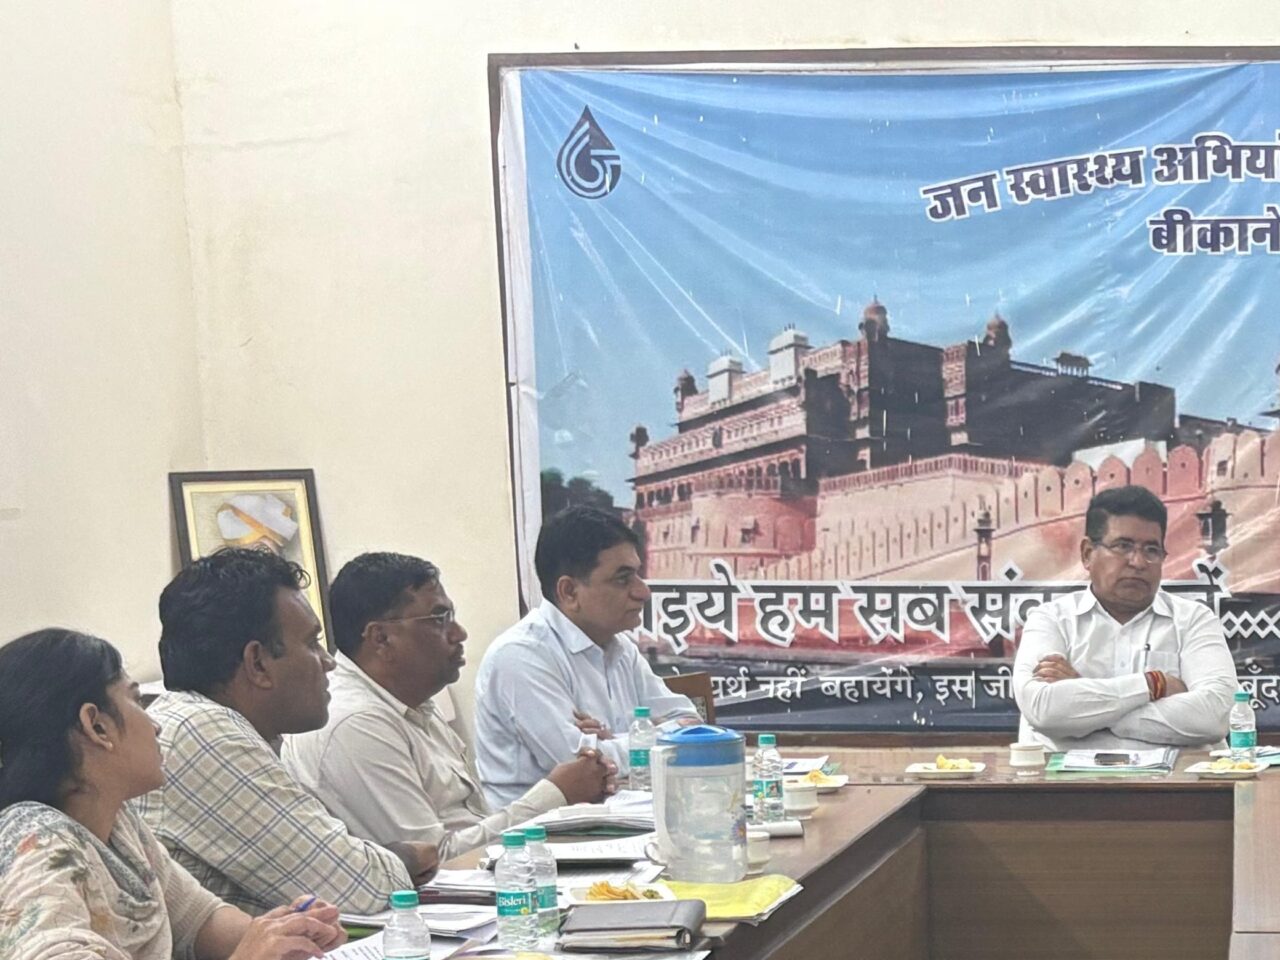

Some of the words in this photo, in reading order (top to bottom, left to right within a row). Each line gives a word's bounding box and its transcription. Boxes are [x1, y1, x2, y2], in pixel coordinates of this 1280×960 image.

[920, 177, 1000, 223] जन
[748, 579, 841, 648] हम
[846, 579, 952, 645] सब
[755, 666, 808, 703] नहीं
[931, 674, 976, 706] इस
